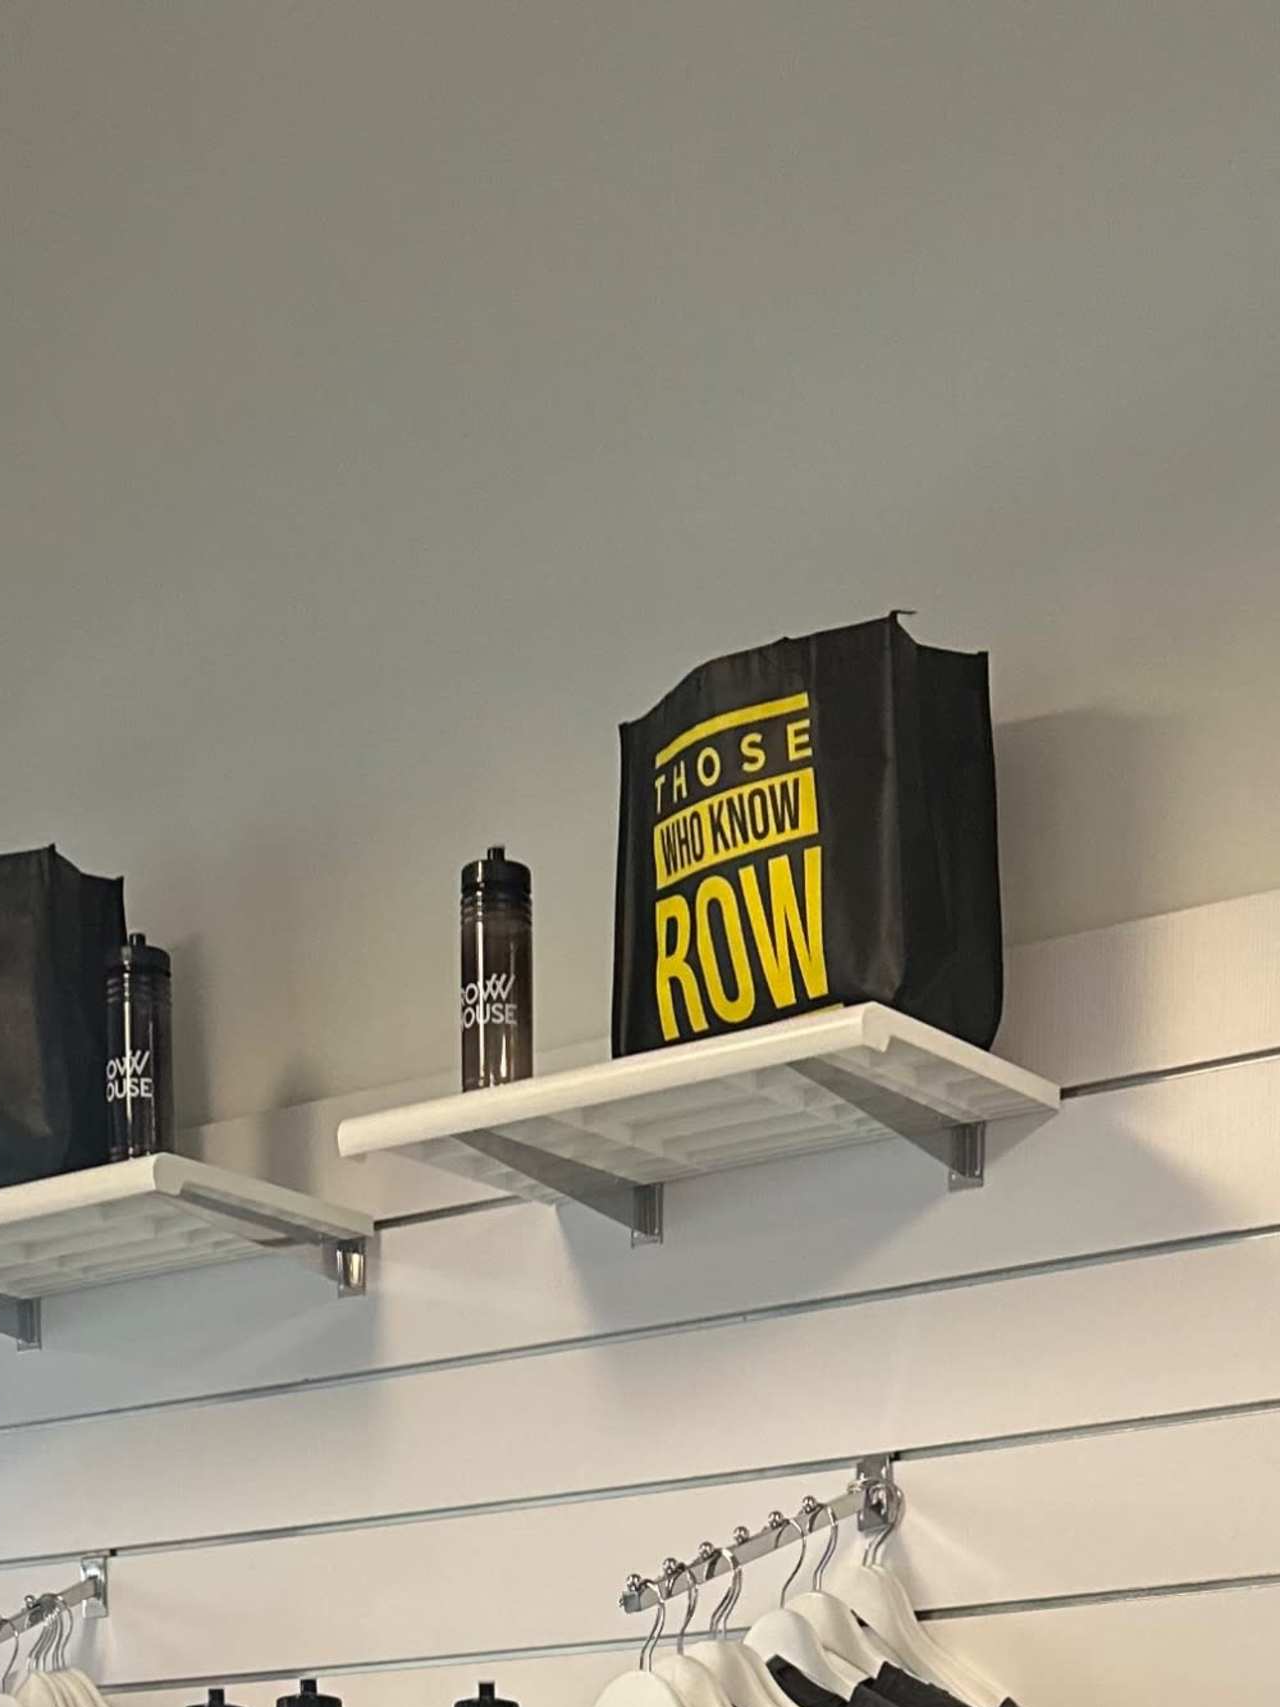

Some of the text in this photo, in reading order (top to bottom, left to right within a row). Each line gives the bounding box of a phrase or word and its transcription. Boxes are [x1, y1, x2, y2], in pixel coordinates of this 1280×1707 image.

[654, 718, 812, 812] THOSE
[660, 777, 802, 876] WHO KNOW
[655, 845, 828, 1042] ROW
[463, 1003, 517, 1029] OUSE
[106, 1049, 150, 1080] OW
[106, 1078, 152, 1102] OUSE
